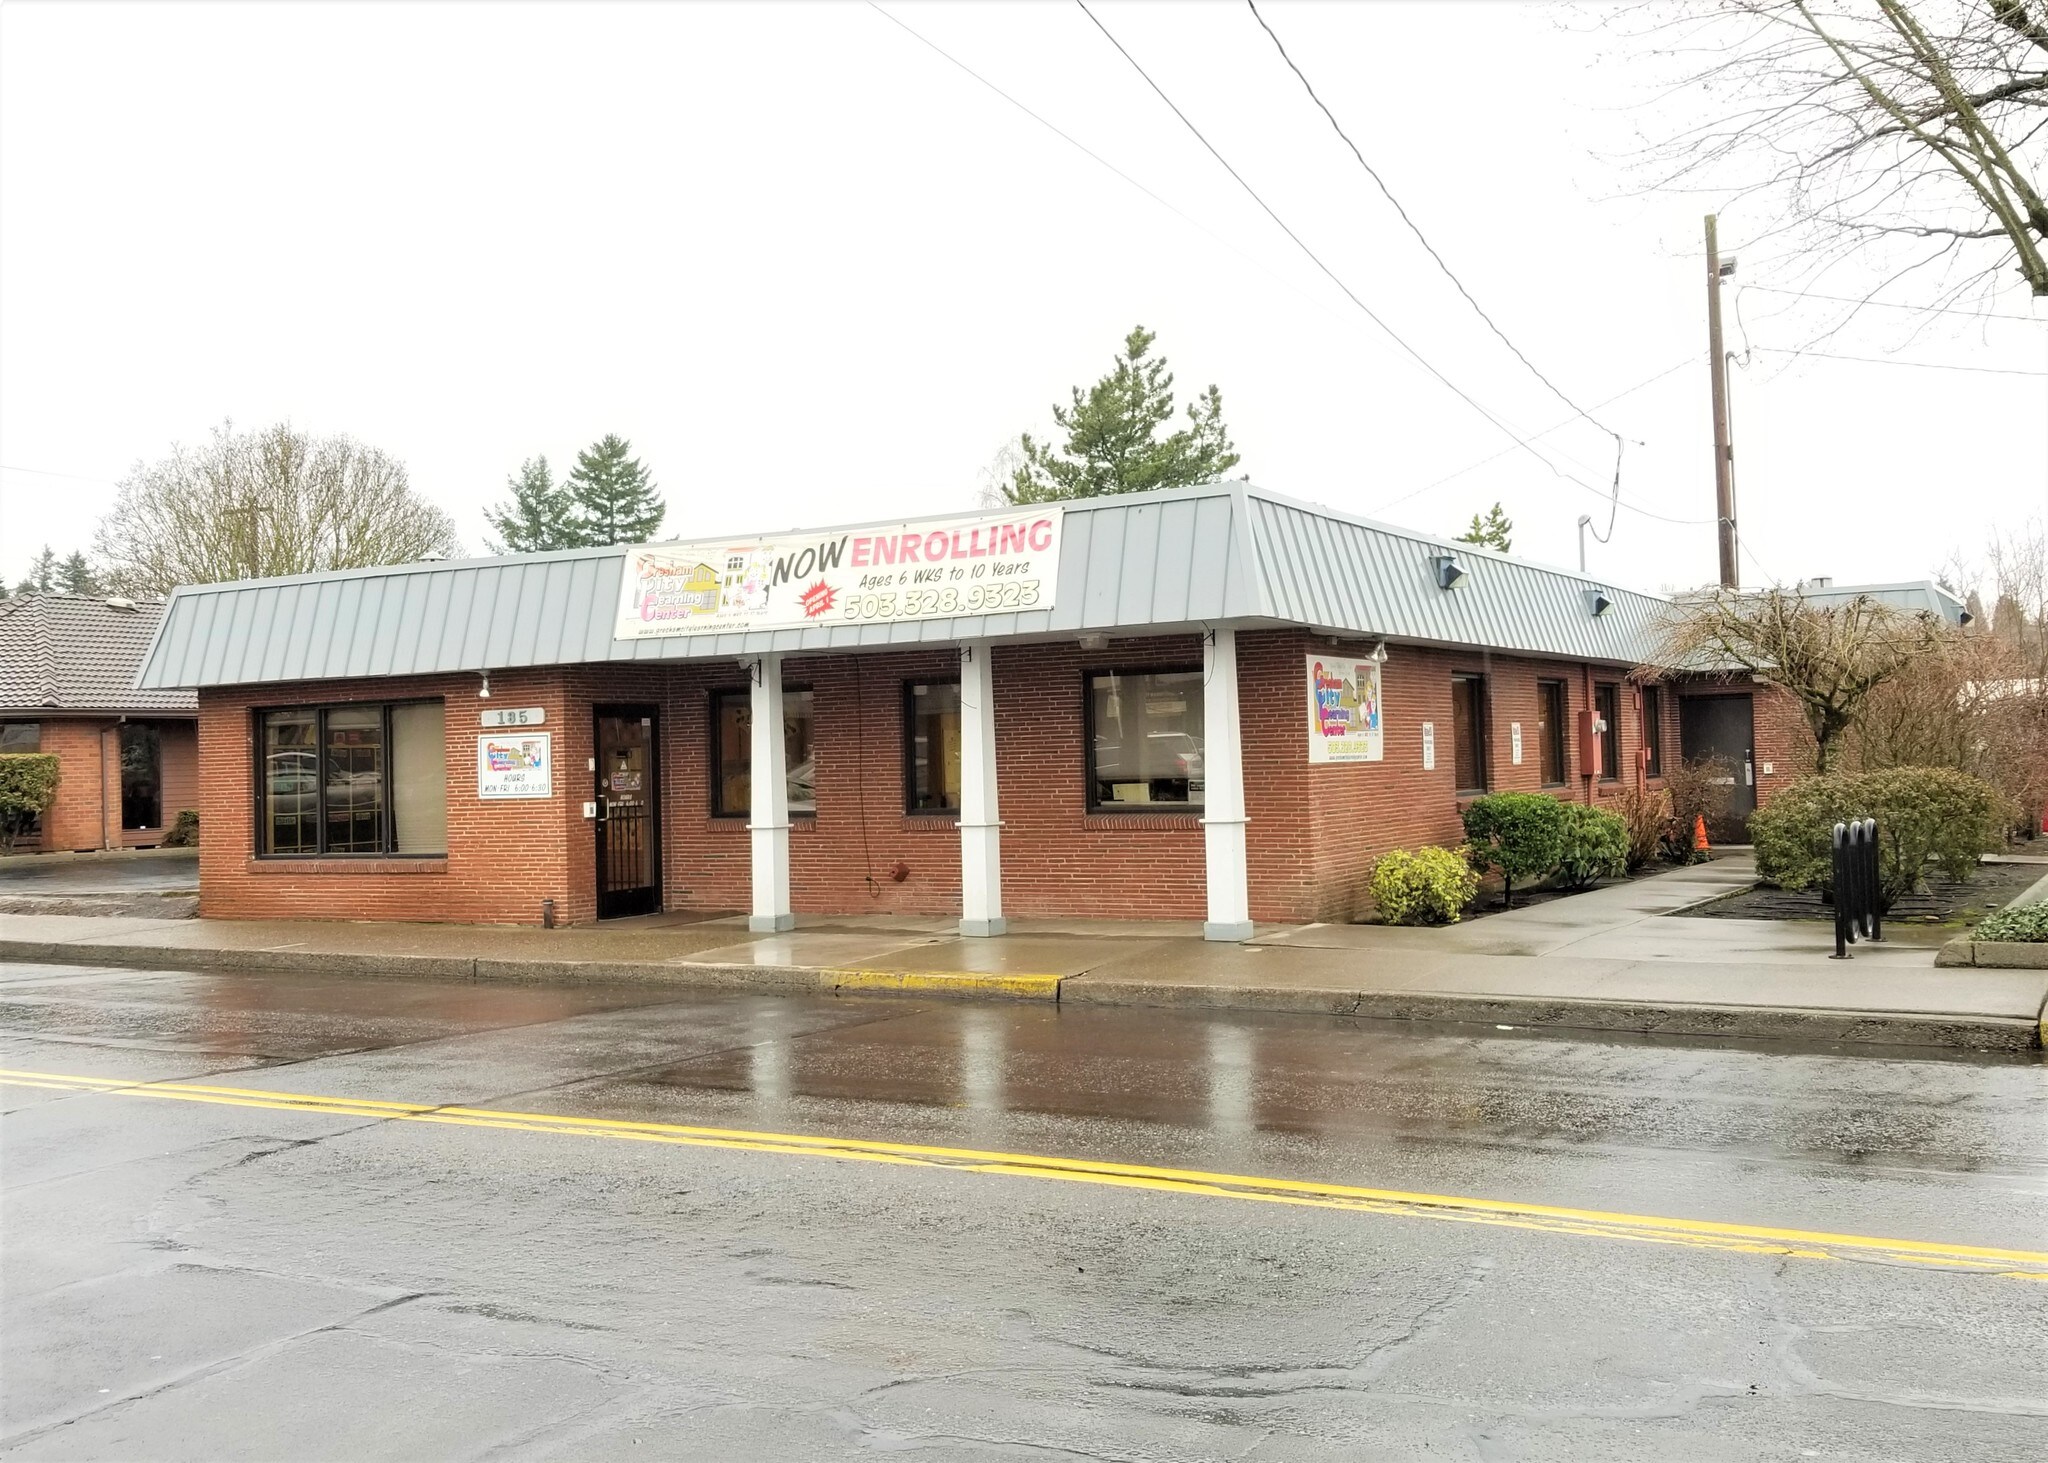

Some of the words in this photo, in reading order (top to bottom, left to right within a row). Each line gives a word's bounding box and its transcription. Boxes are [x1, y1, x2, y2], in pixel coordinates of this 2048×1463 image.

[636, 554, 693, 579] Gresham
[773, 535, 848, 587] NOW
[850, 519, 1053, 567] ENROLLING
[859, 573, 892, 591] Ages
[898, 570, 908, 585] 6
[913, 567, 944, 584] WKS
[950, 566, 964, 580] to
[970, 563, 986, 579] 10
[992, 561, 1030, 575] Years
[843, 579, 1041, 620] 503.328.9323
[641, 606, 691, 622] Center
[504, 773, 525, 783] HOURS
